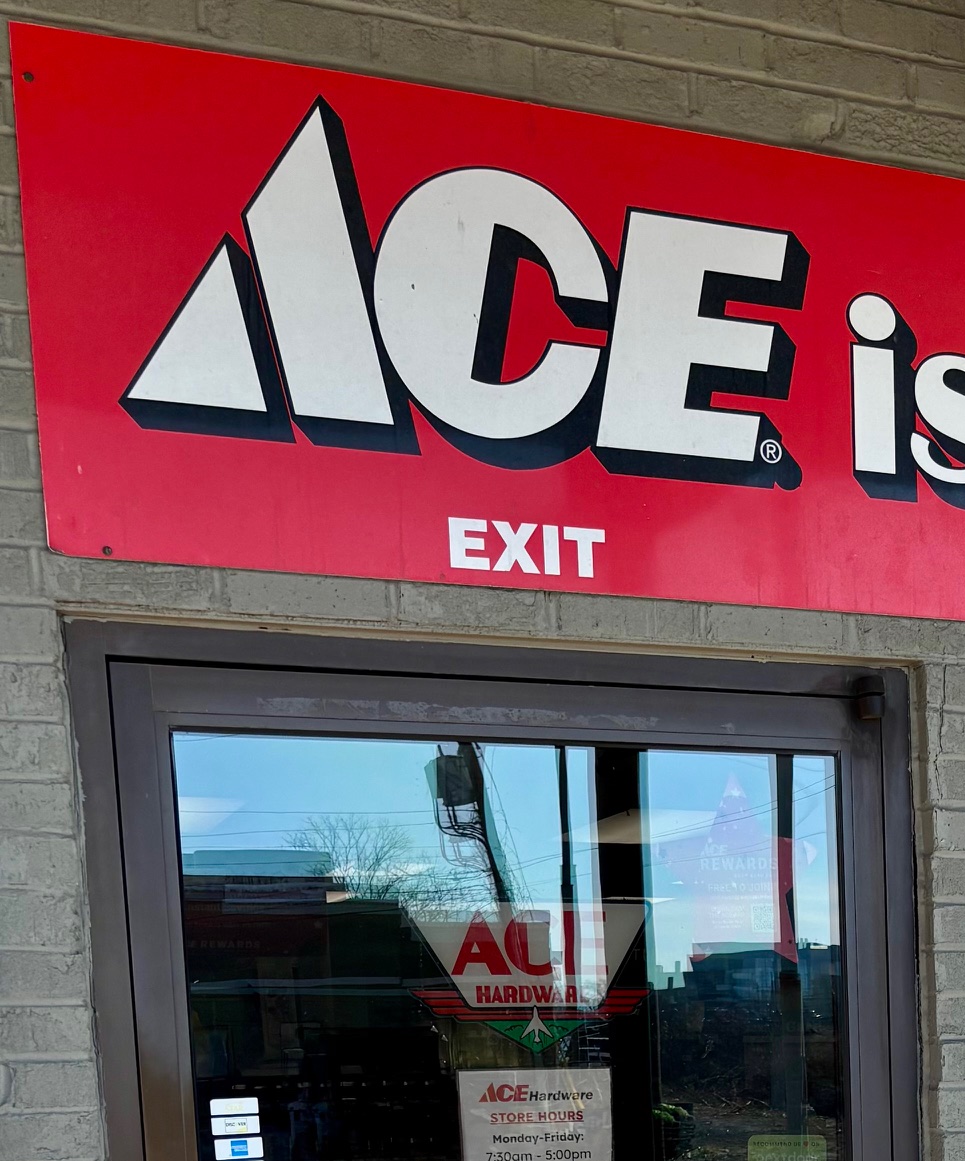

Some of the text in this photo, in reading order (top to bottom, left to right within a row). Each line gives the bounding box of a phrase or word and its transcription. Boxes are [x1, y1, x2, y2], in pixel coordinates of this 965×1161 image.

[123, 98, 795, 470] ACE
[448, 517, 606, 579] EXIT
[700, 857, 778, 870] REWARDS
[451, 910, 608, 976] ACE
[479, 1082, 593, 1103] ACE Hardware
[490, 1111, 584, 1123] STORE HOURS
[492, 1132, 584, 1145] Monday-Friday:
[545, 1149, 592, 1161] 5:00pm
